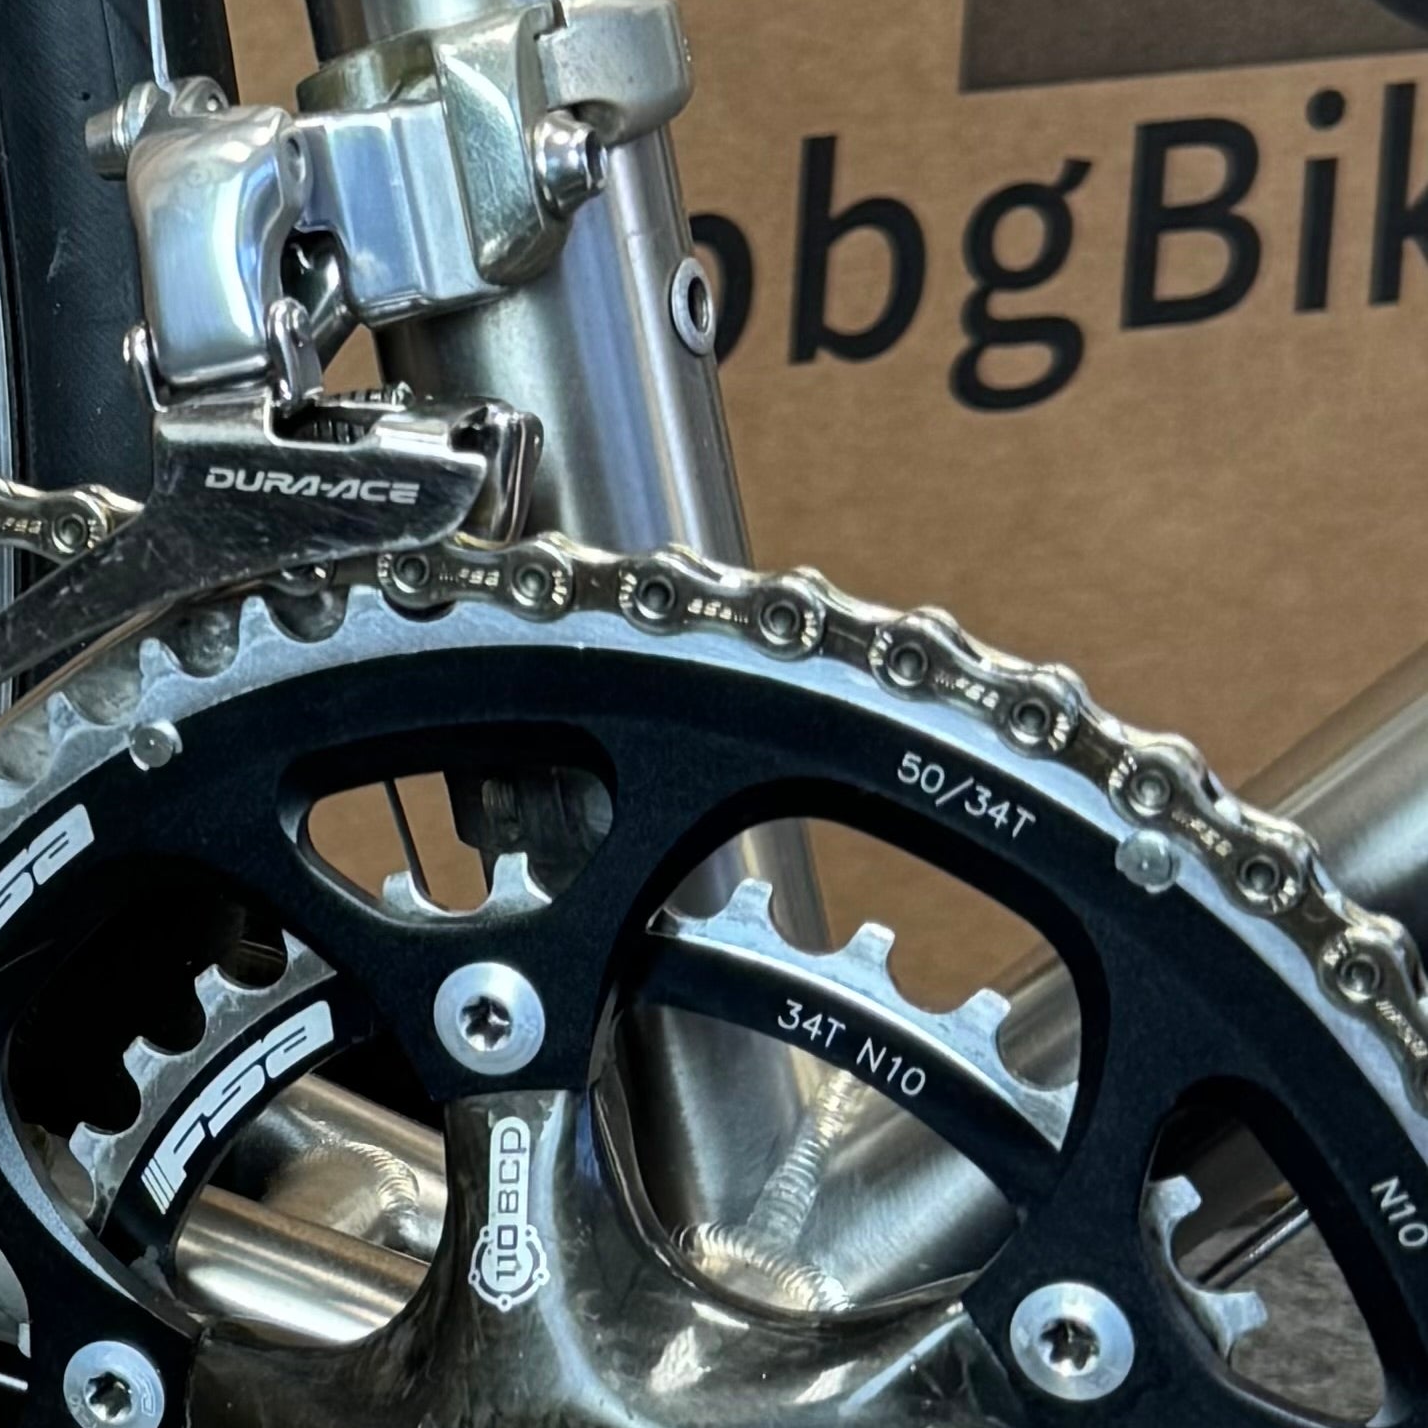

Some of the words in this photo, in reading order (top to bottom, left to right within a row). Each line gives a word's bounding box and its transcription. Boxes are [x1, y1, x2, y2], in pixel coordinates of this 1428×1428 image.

[204, 466, 421, 505] DURA-ACE
[897, 750, 1036, 839] 50/34T
[776, 998, 846, 1049] 34T
[855, 1037, 927, 1097] N10
[141, 1000, 334, 1215] FSA
[1370, 1176, 1428, 1248] N10
